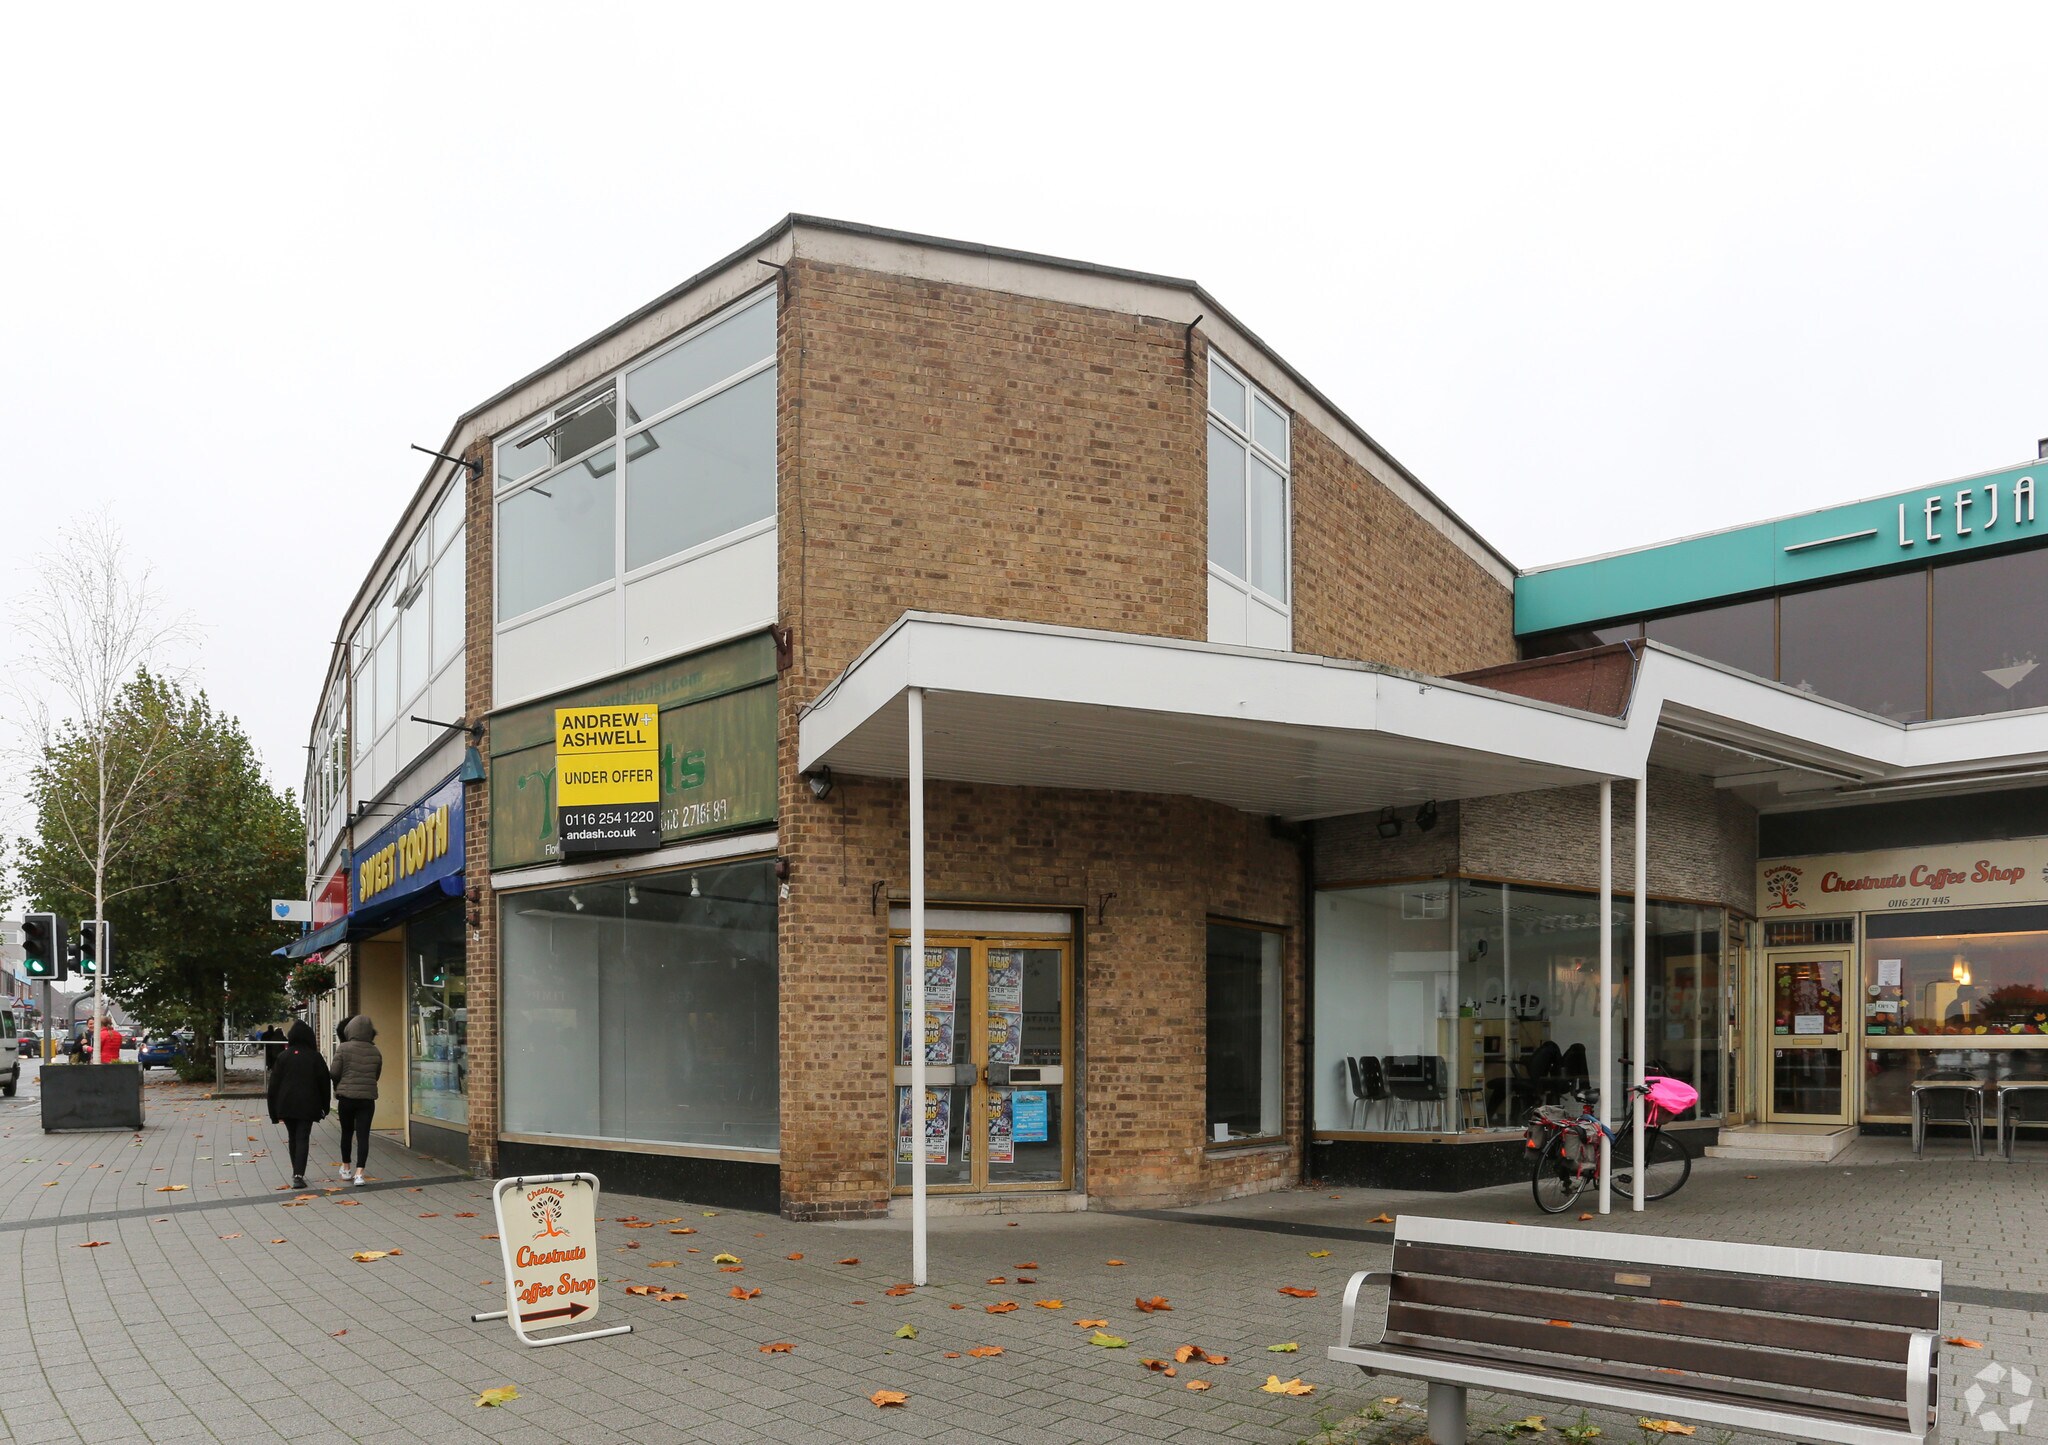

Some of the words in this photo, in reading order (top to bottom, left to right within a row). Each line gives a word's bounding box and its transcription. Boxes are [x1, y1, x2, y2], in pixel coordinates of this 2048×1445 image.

[562, 730, 647, 747] ASHWELL
[564, 770, 608, 785] UNDER
[611, 769, 653, 783] OFFER
[565, 813, 596, 826] 0116
[598, 812, 622, 825] 254
[624, 810, 654, 824] 1220
[566, 827, 637, 840] andash.co.uk
[359, 842, 396, 904] SWEET
[397, 803, 449, 880] TOOTH
[1820, 871, 1906, 894] Chestnuts
[1909, 864, 1966, 891] Coffee
[1970, 859, 2026, 885] Shop
[1888, 898, 1908, 908] 0116
[1909, 896, 1930, 907] 2711
[1932, 895, 1951, 906] 445
[527, 1186, 565, 1201] Chestnuts
[516, 1245, 586, 1268] Chestnuts
[557, 1273, 596, 1296] Shop
